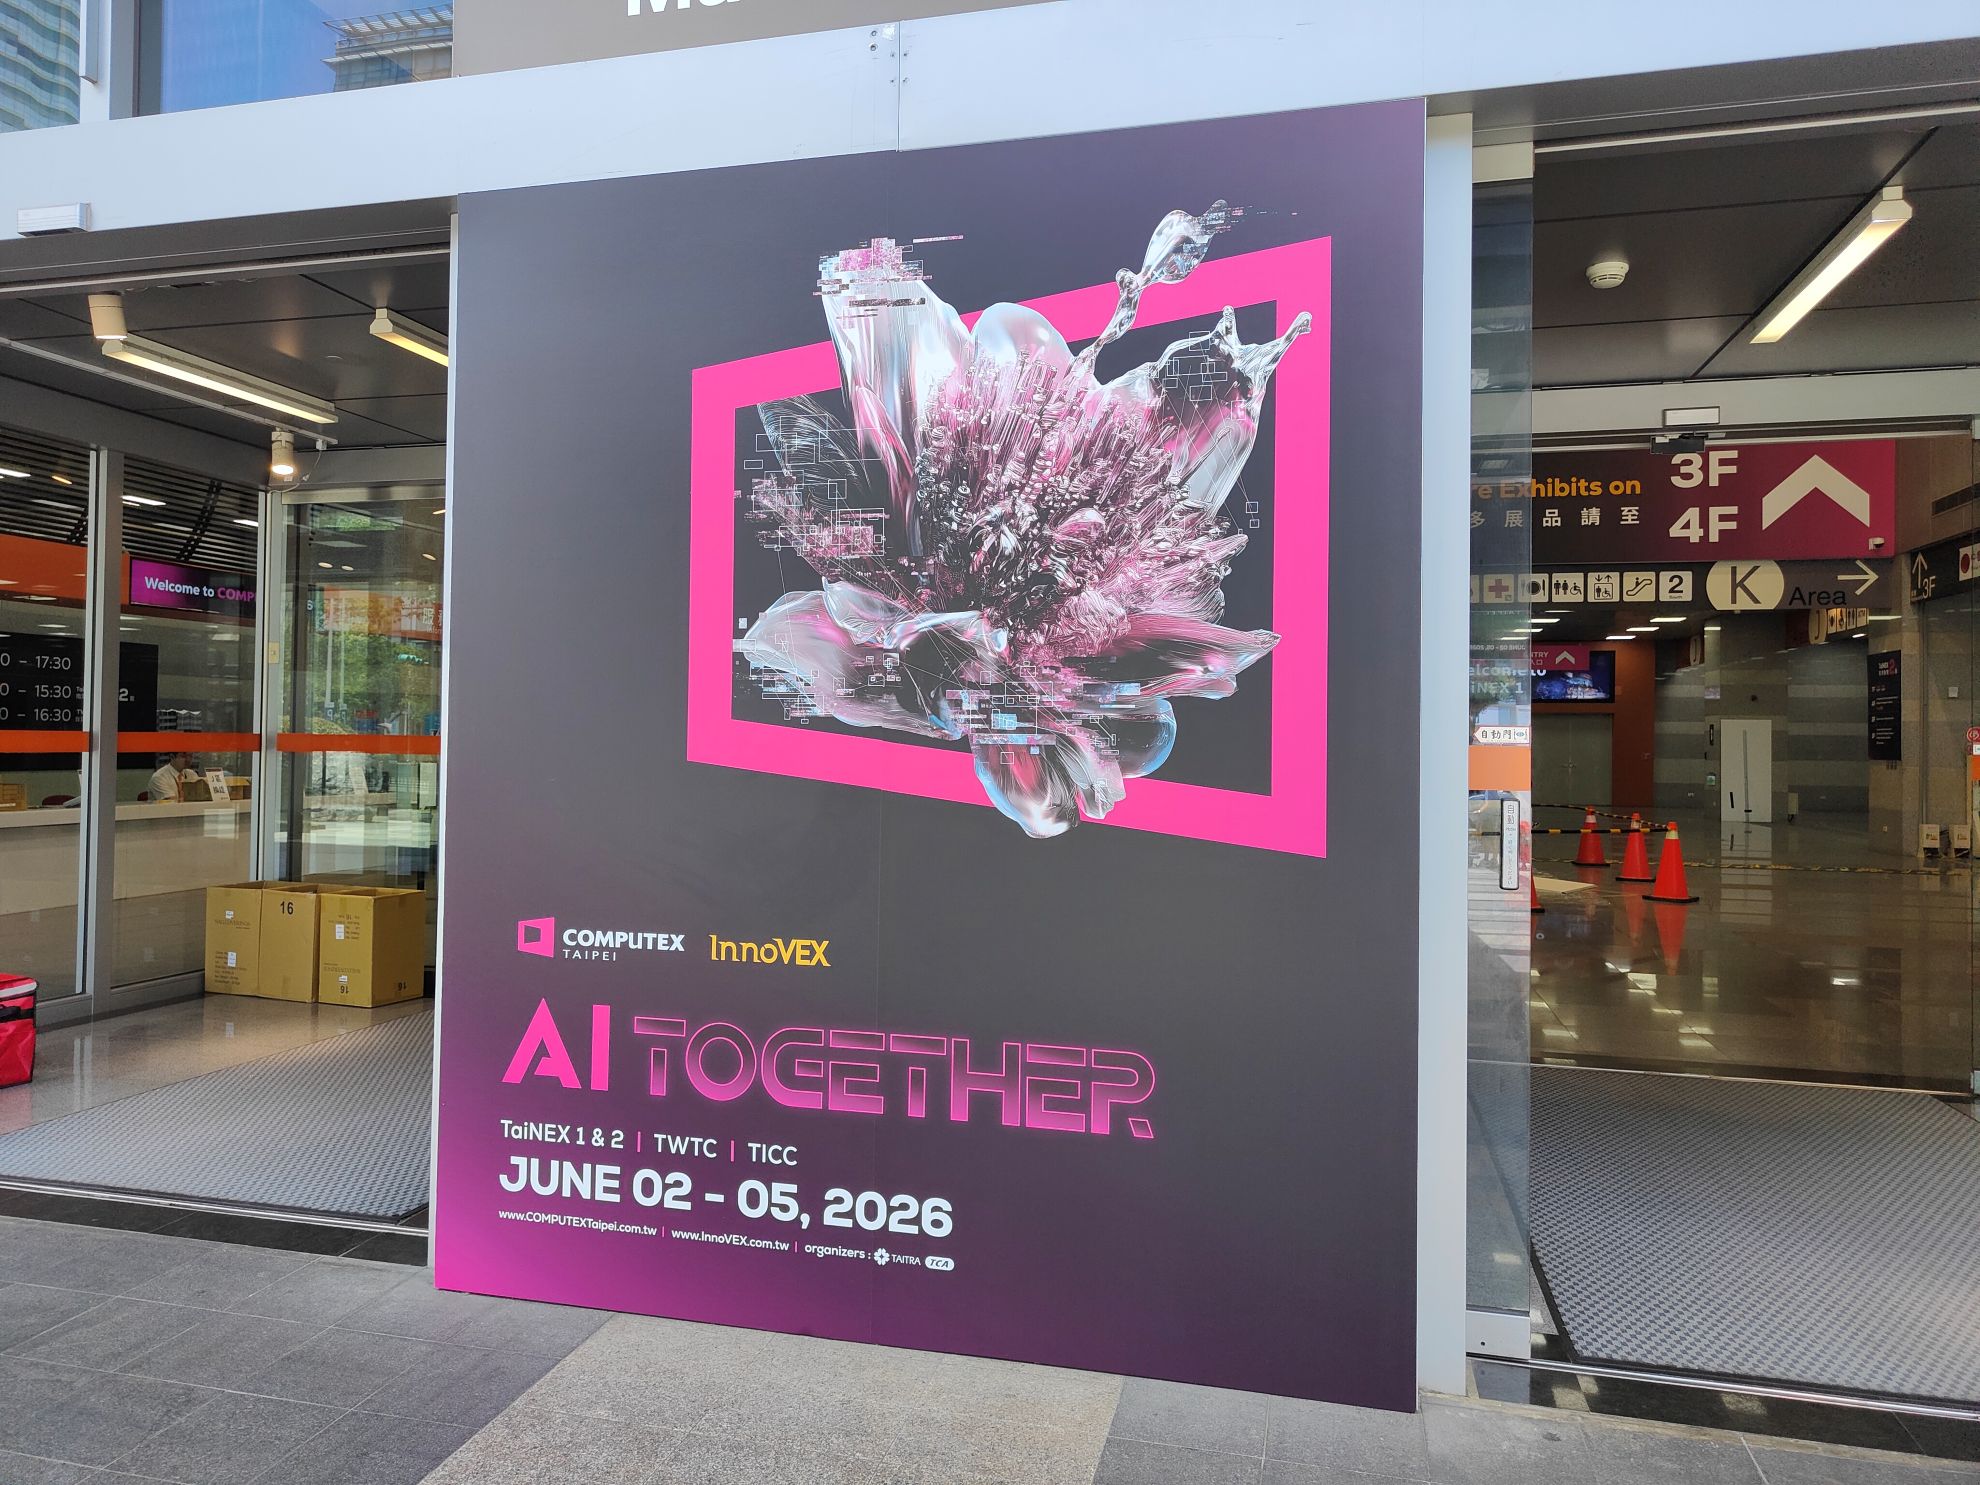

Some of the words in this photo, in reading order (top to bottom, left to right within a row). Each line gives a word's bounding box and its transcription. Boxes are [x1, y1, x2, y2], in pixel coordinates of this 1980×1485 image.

[1670, 450, 1738, 488] 3F
[1500, 477, 1603, 500] Exhibits
[1609, 479, 1641, 496] on
[1669, 506, 1738, 543] 4F
[144, 575, 200, 596] Welcome
[202, 585, 215, 597] to
[217, 587, 256, 602] COMP
[1668, 574, 1683, 593] 2
[1730, 565, 1761, 605] K
[1922, 575, 1936, 599] 3F
[1788, 587, 1847, 606] Area
[35, 655, 71, 670] 17:30
[35, 684, 71, 698] 15:30
[34, 708, 71, 721] 16:30
[280, 901, 294, 915] 16
[562, 928, 685, 952] COMPUTEX
[709, 934, 832, 967] InnoVEX
[562, 949, 617, 962] TAIPEI
[501, 998, 611, 1091] AI
[500, 1119, 571, 1144] TaiNEX
[575, 1126, 585, 1145] 1
[591, 1128, 605, 1147] &
[611, 1129, 625, 1149] 2
[653, 1133, 718, 1159] TWTC
[747, 1142, 798, 1166] TICC
[499, 1155, 621, 1203] JUNE
[632, 1168, 692, 1211] 02
[737, 1179, 811, 1229] 05,
[823, 1187, 953, 1238] 2026
[498, 1209, 657, 1236] www.COMPUTEXTaipei.com.tw
[671, 1228, 790, 1252] www.InnoVEX.com.tw
[891, 1253, 921, 1266] TAITRA
[928, 1257, 951, 1269] TCA
